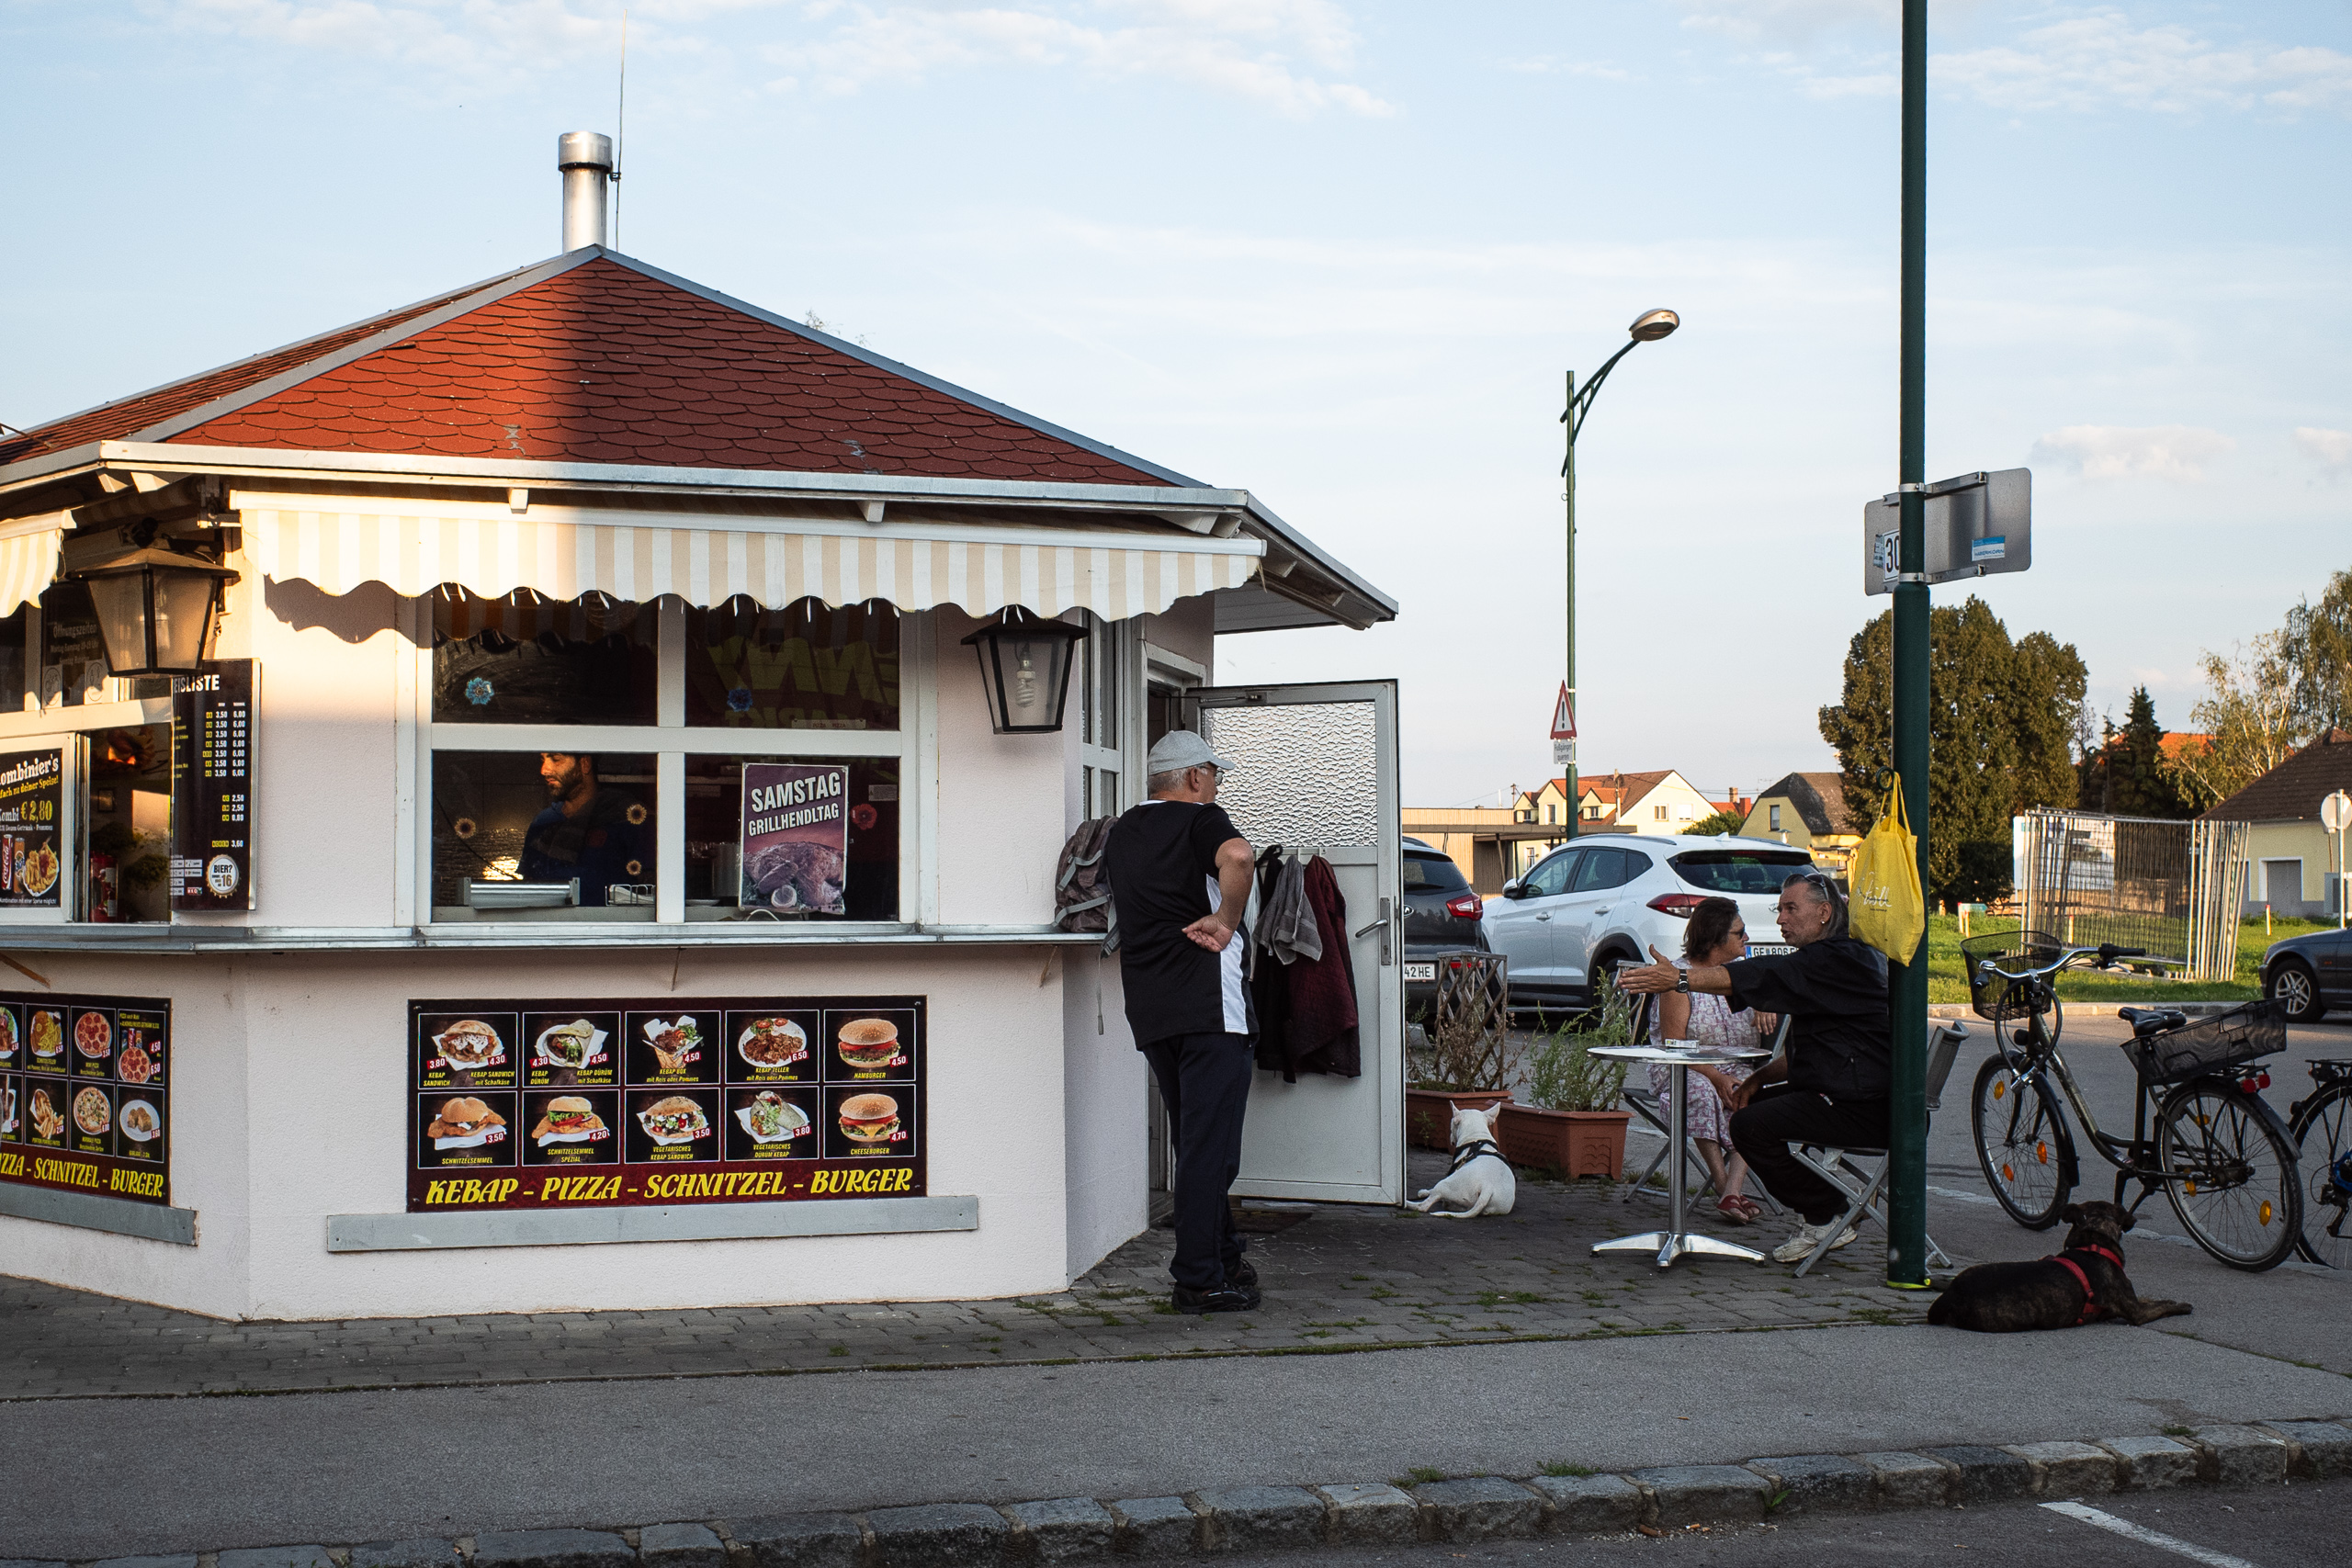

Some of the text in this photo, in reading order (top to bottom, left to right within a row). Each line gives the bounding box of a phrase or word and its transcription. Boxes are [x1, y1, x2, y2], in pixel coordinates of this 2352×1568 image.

[1885, 535, 1899, 573] 30
[751, 772, 842, 813] SAMSTAG
[21, 801, 27, 820] €
[29, 800, 53, 822] 2,80
[748, 803, 840, 837] GRILLHENDLTAG
[213, 865, 233, 873] BIER?
[221, 874, 232, 887] 16
[1405, 966, 1430, 977] 42 HE
[34, 1158, 99, 1188] SCHNITZEL
[111, 1169, 164, 1198] BURGER
[426, 1177, 519, 1205] KEBAP
[541, 1176, 622, 1201] PIZZA
[644, 1171, 787, 1198] SCHNITZEL
[811, 1168, 913, 1195] BURGER
